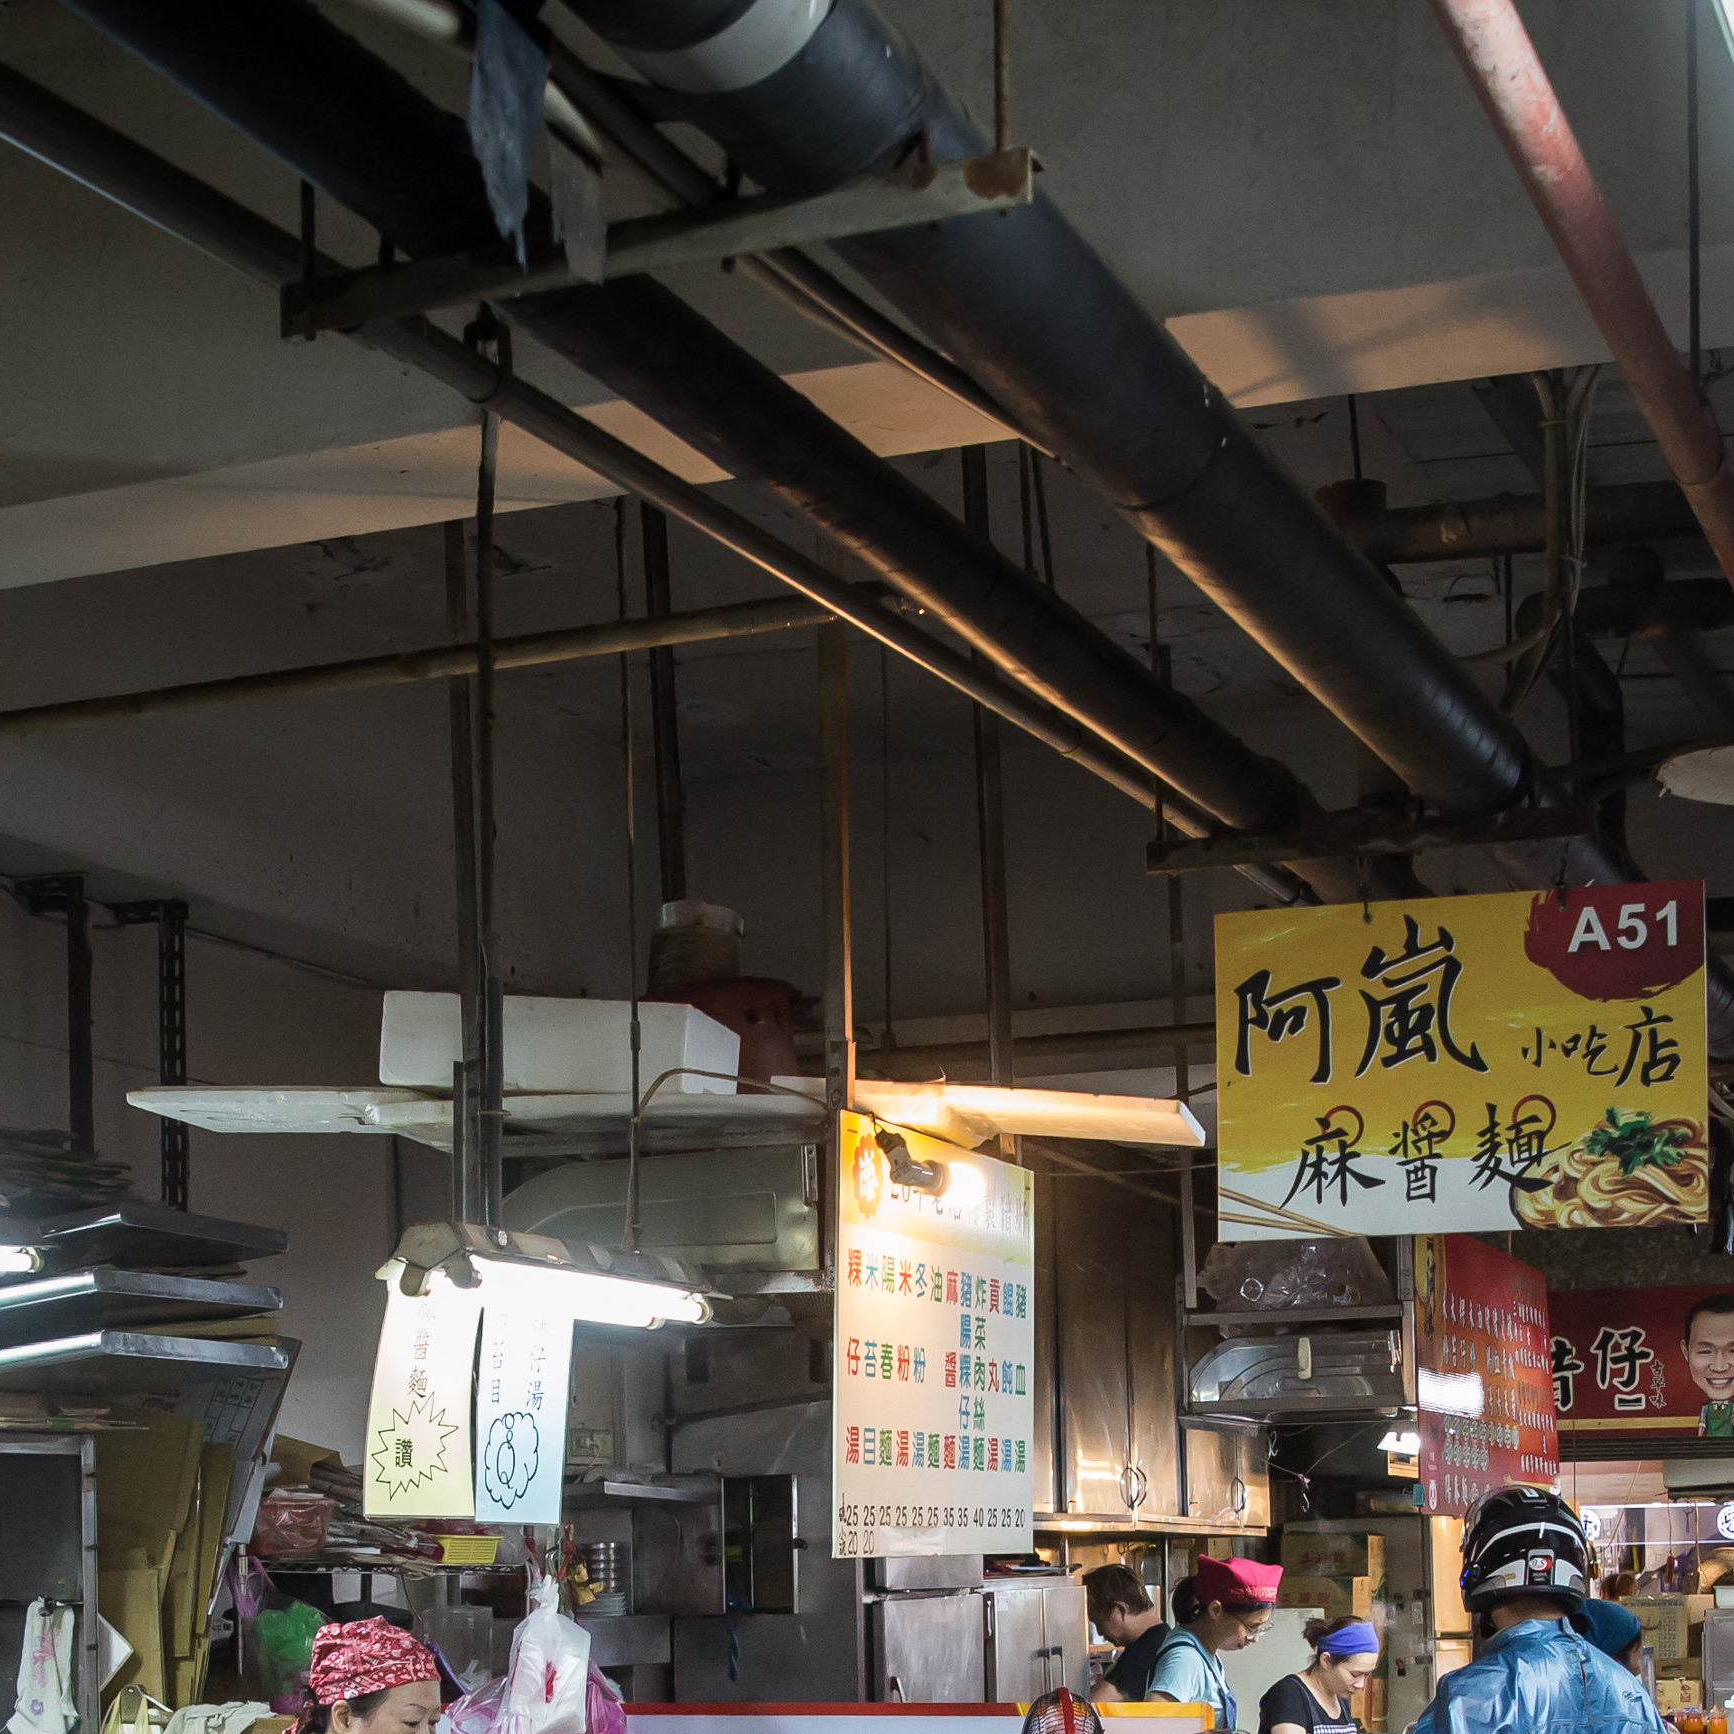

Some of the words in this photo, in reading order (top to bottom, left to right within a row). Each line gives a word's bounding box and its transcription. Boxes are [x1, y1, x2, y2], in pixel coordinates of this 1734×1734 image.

[1233, 914, 1490, 1084] 阿嵐
[1521, 1006, 1683, 1088] 小吃店
[1567, 900, 1679, 953] A51
[1279, 1103, 1571, 1211] 麻醬麵
[846, 1247, 864, 1465] 粿仔湯
[863, 1252, 879, 1465] 米苔目
[879, 1255, 896, 1466] 陽春麵
[895, 1259, 912, 1467] 米粉湯
[912, 1263, 928, 1468] 冬粉湯
[944, 1269, 959, 1470] 麻醬麵
[987, 1278, 1000, 1473] 貢丸湯
[1001, 1282, 1014, 1473] 餛飩湯
[1014, 1283, 1027, 1474] 豬血湯
[1649, 1360, 1667, 1410] 古早味
[394, 1438, 414, 1468] 讚
[846, 1504, 859, 1527] 25
[863, 1504, 876, 1527] 25
[879, 1505, 892, 1528] 25
[895, 1505, 908, 1528] 25
[911, 1505, 924, 1528] 25
[927, 1506, 940, 1529] 25
[943, 1506, 955, 1529] 35
[957, 1507, 969, 1530] 35
[973, 1507, 985, 1528] 40
[987, 1507, 998, 1528] 25
[1001, 1508, 1013, 1529] 25
[1014, 1508, 1026, 1529] 20
[848, 1530, 859, 1555] 20
[862, 1529, 875, 1555] 20
